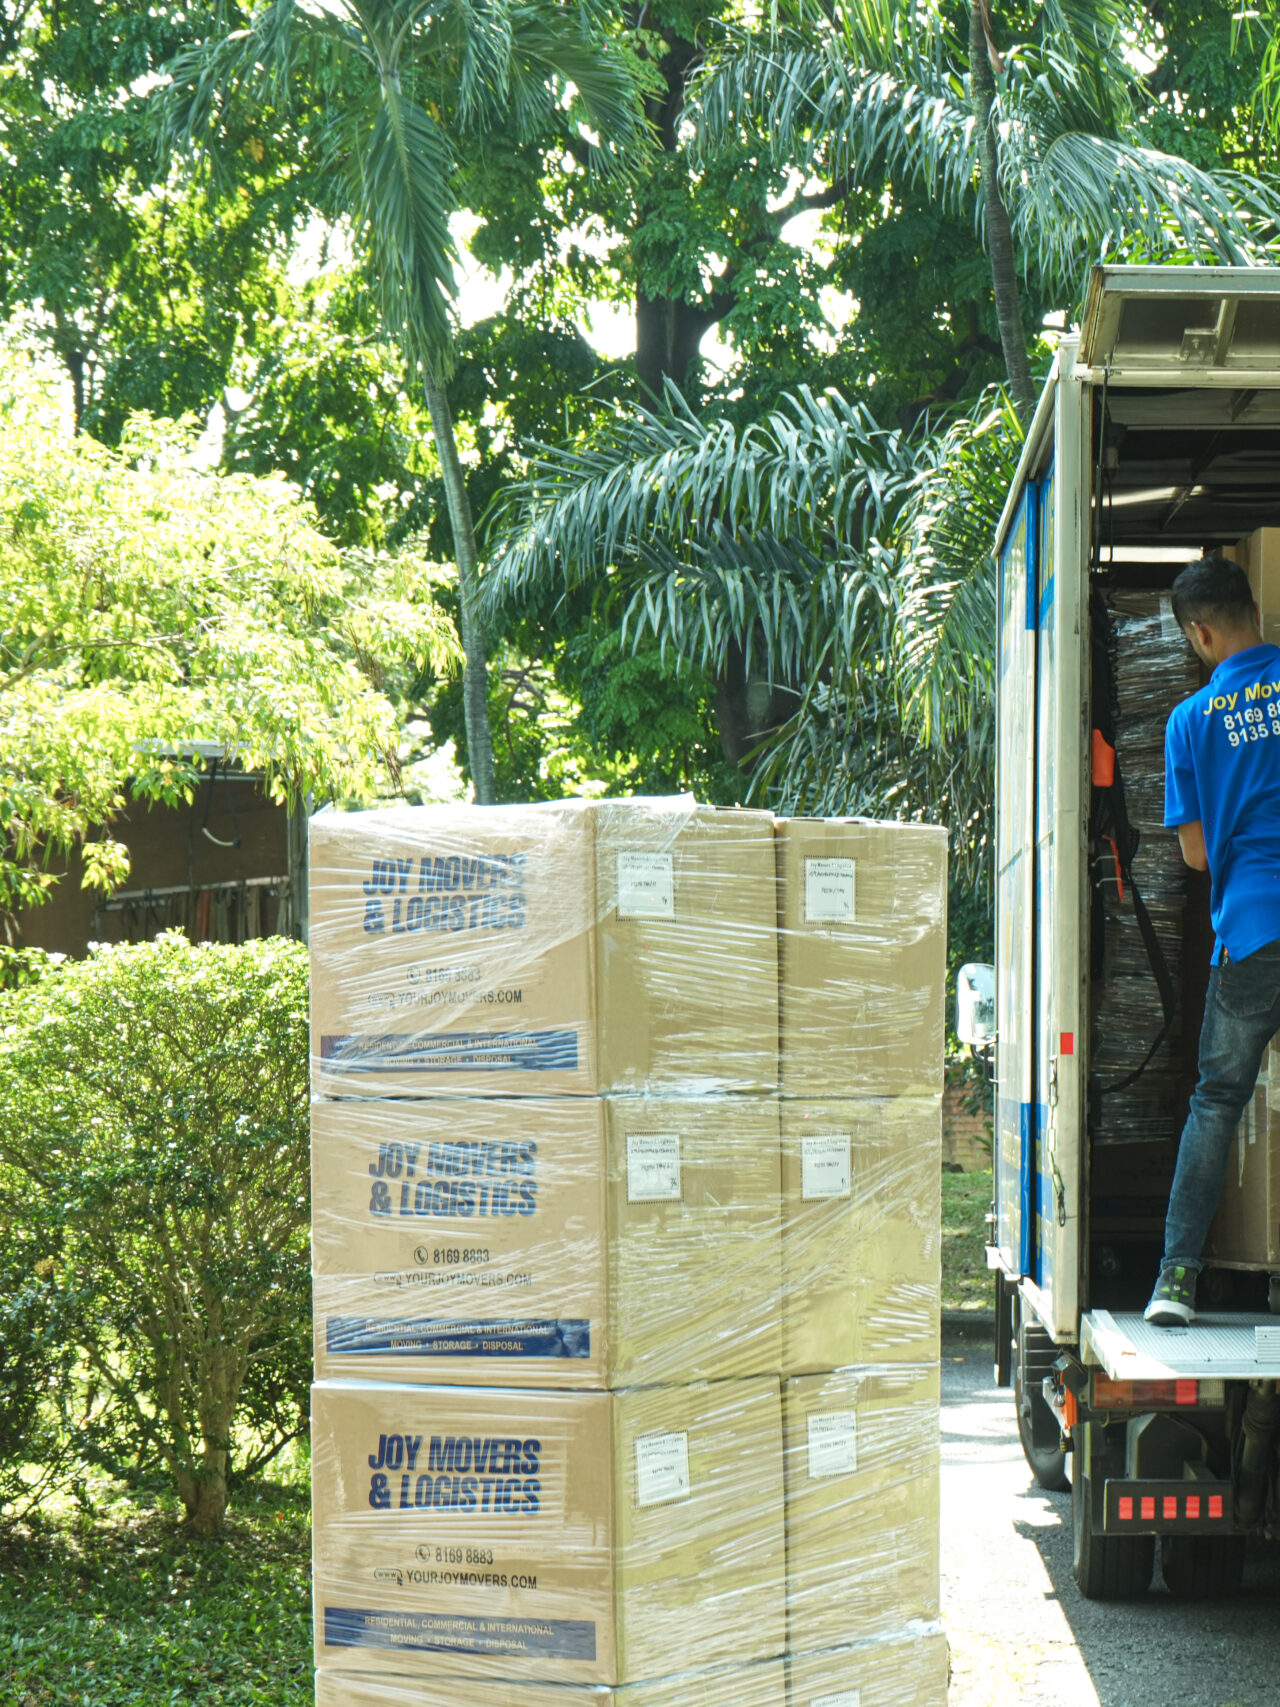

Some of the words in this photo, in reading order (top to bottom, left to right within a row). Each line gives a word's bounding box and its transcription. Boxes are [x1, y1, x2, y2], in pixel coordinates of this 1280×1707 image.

[1203, 692, 1239, 715] Joy
[1223, 707, 1263, 730] 8169
[1228, 723, 1269, 747] 9135
[362, 857, 413, 896] JOY
[419, 853, 527, 893] MOVERS
[363, 898, 386, 935] &
[391, 892, 527, 934] LOGISTICS
[368, 1142, 421, 1178] JOY
[427, 1140, 538, 1177] MOVERS
[368, 1180, 392, 1217] &
[399, 1180, 538, 1217] LOGISTICS
[433, 1248, 460, 1264] 8169
[462, 1248, 490, 1264] 8883
[390, 1339, 422, 1350] MOVING
[432, 1340, 472, 1351] STORAGE
[482, 1340, 524, 1351] DISPOSAL
[368, 1433, 422, 1471] JOY
[428, 1435, 543, 1475] MOVERS
[368, 1472, 391, 1510] &
[400, 1473, 543, 1516] LOGISTICS
[435, 1547, 463, 1564] 8169
[466, 1547, 494, 1566] 8883
[406, 1570, 538, 1590] YOURJOYMOVERS.COM
[364, 1615, 420, 1630] RESIDENTIAL,
[421, 1619, 478, 1632] COMMERCIAL
[487, 1622, 555, 1637] INTERNATIONAL
[390, 1633, 424, 1645] MOVING
[434, 1636, 475, 1648] STORAGE
[485, 1638, 528, 1651] DISPOSAL
